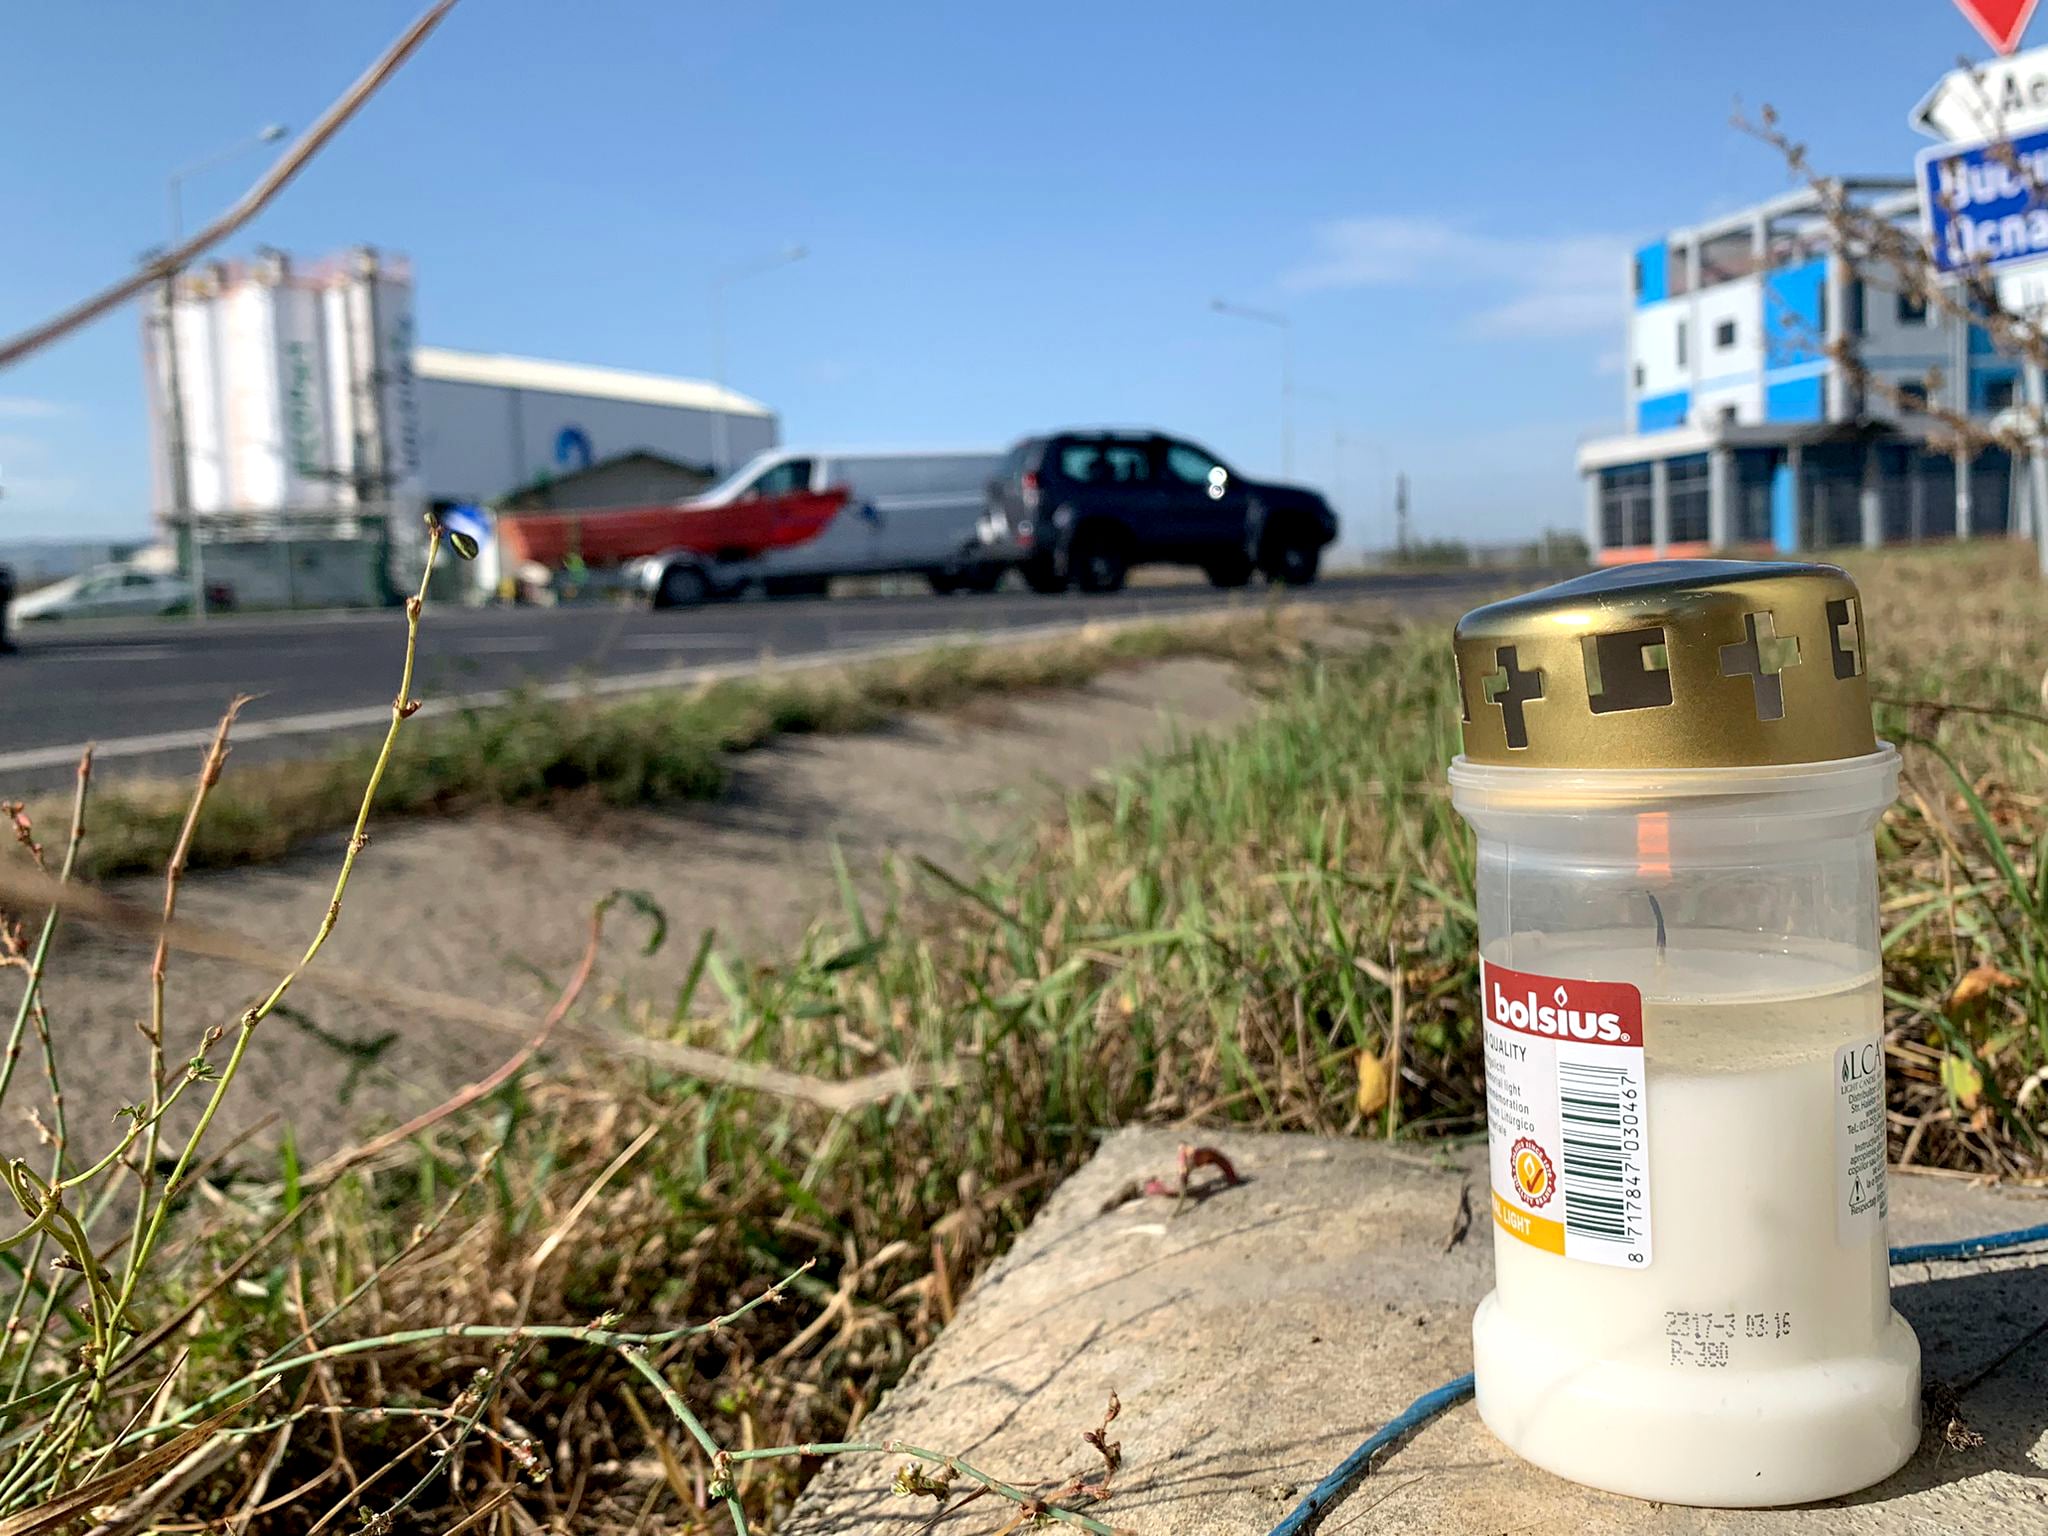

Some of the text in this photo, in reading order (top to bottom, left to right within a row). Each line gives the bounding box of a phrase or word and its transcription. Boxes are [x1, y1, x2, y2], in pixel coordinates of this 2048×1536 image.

[1494, 982, 1622, 1042] bolsius
[1489, 1033, 1527, 1062] QUALITY
[1621, 1076, 1644, 1263] 8 717847 030467
[1502, 1205, 1531, 1236] LIGHT
